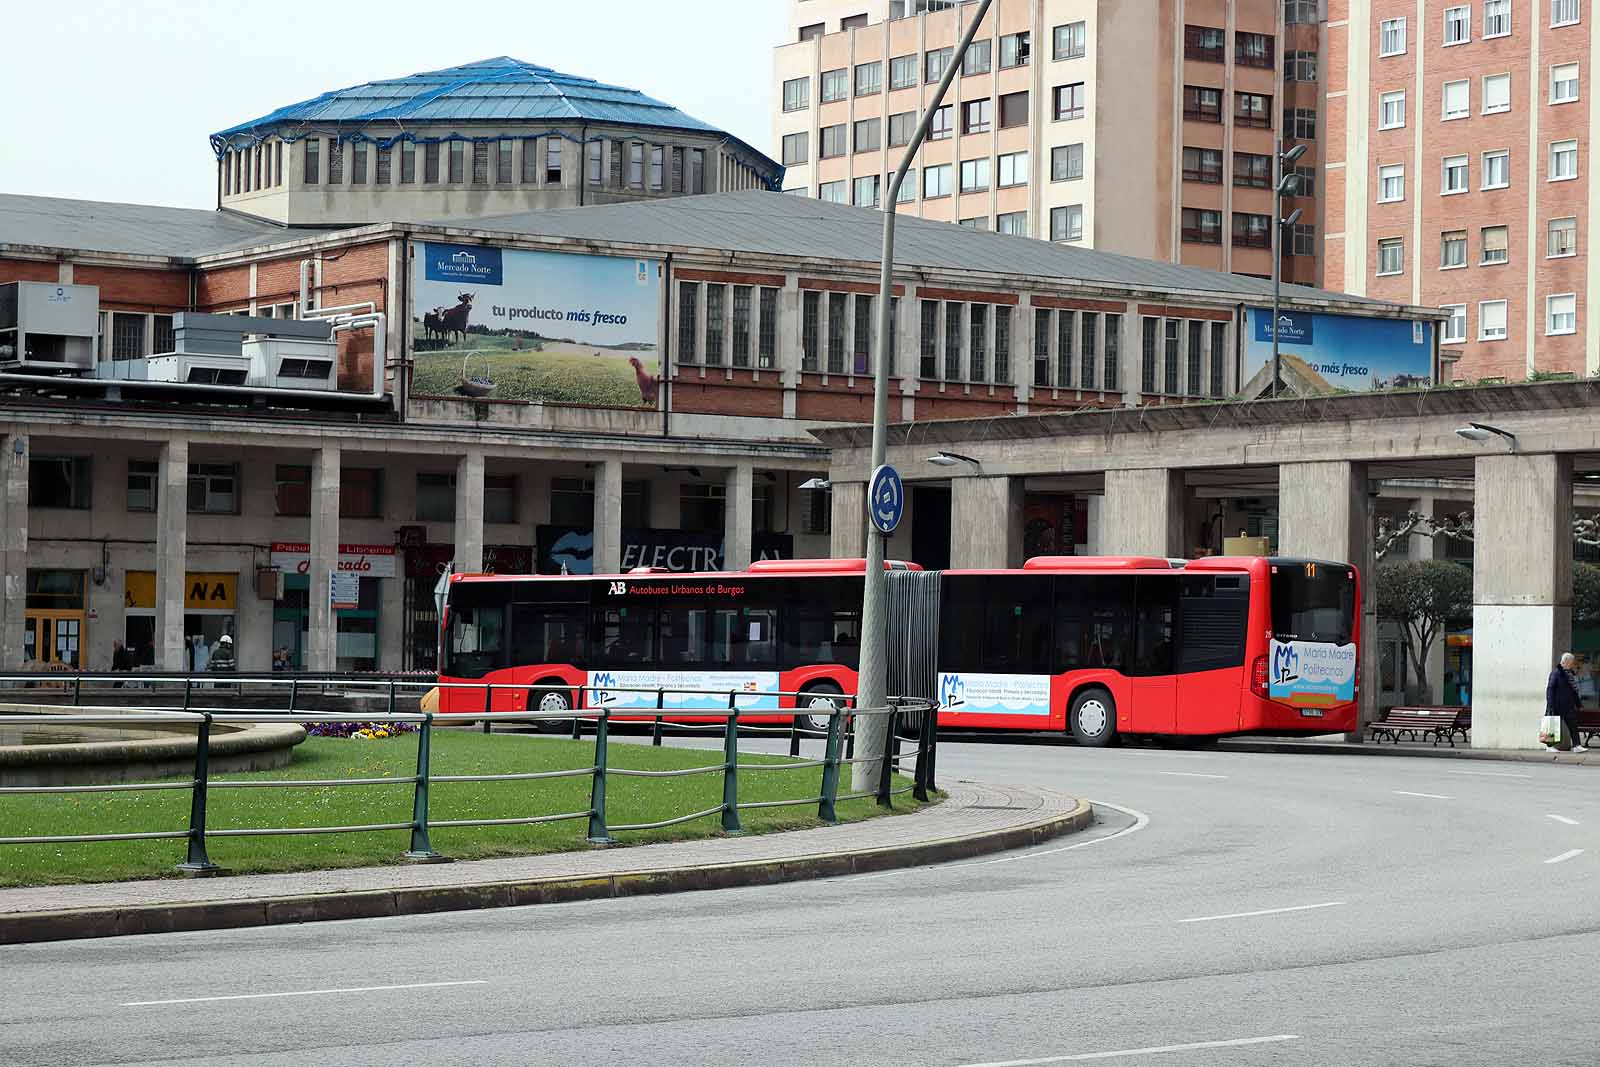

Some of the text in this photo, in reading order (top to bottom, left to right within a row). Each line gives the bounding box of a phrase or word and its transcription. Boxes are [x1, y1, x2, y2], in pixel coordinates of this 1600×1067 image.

[438, 261, 492, 274] Mercado Norte
[492, 304, 627, 326] tu producto más fresco
[1289, 325, 1305, 336] Norte
[1321, 361, 1340, 373] más
[1340, 362, 1368, 377] fresco
[1306, 561, 1317, 577] 11
[608, 581, 745, 597] AB Autobuses Urbanos de Burgos
[1329, 648, 1354, 660] Madre
